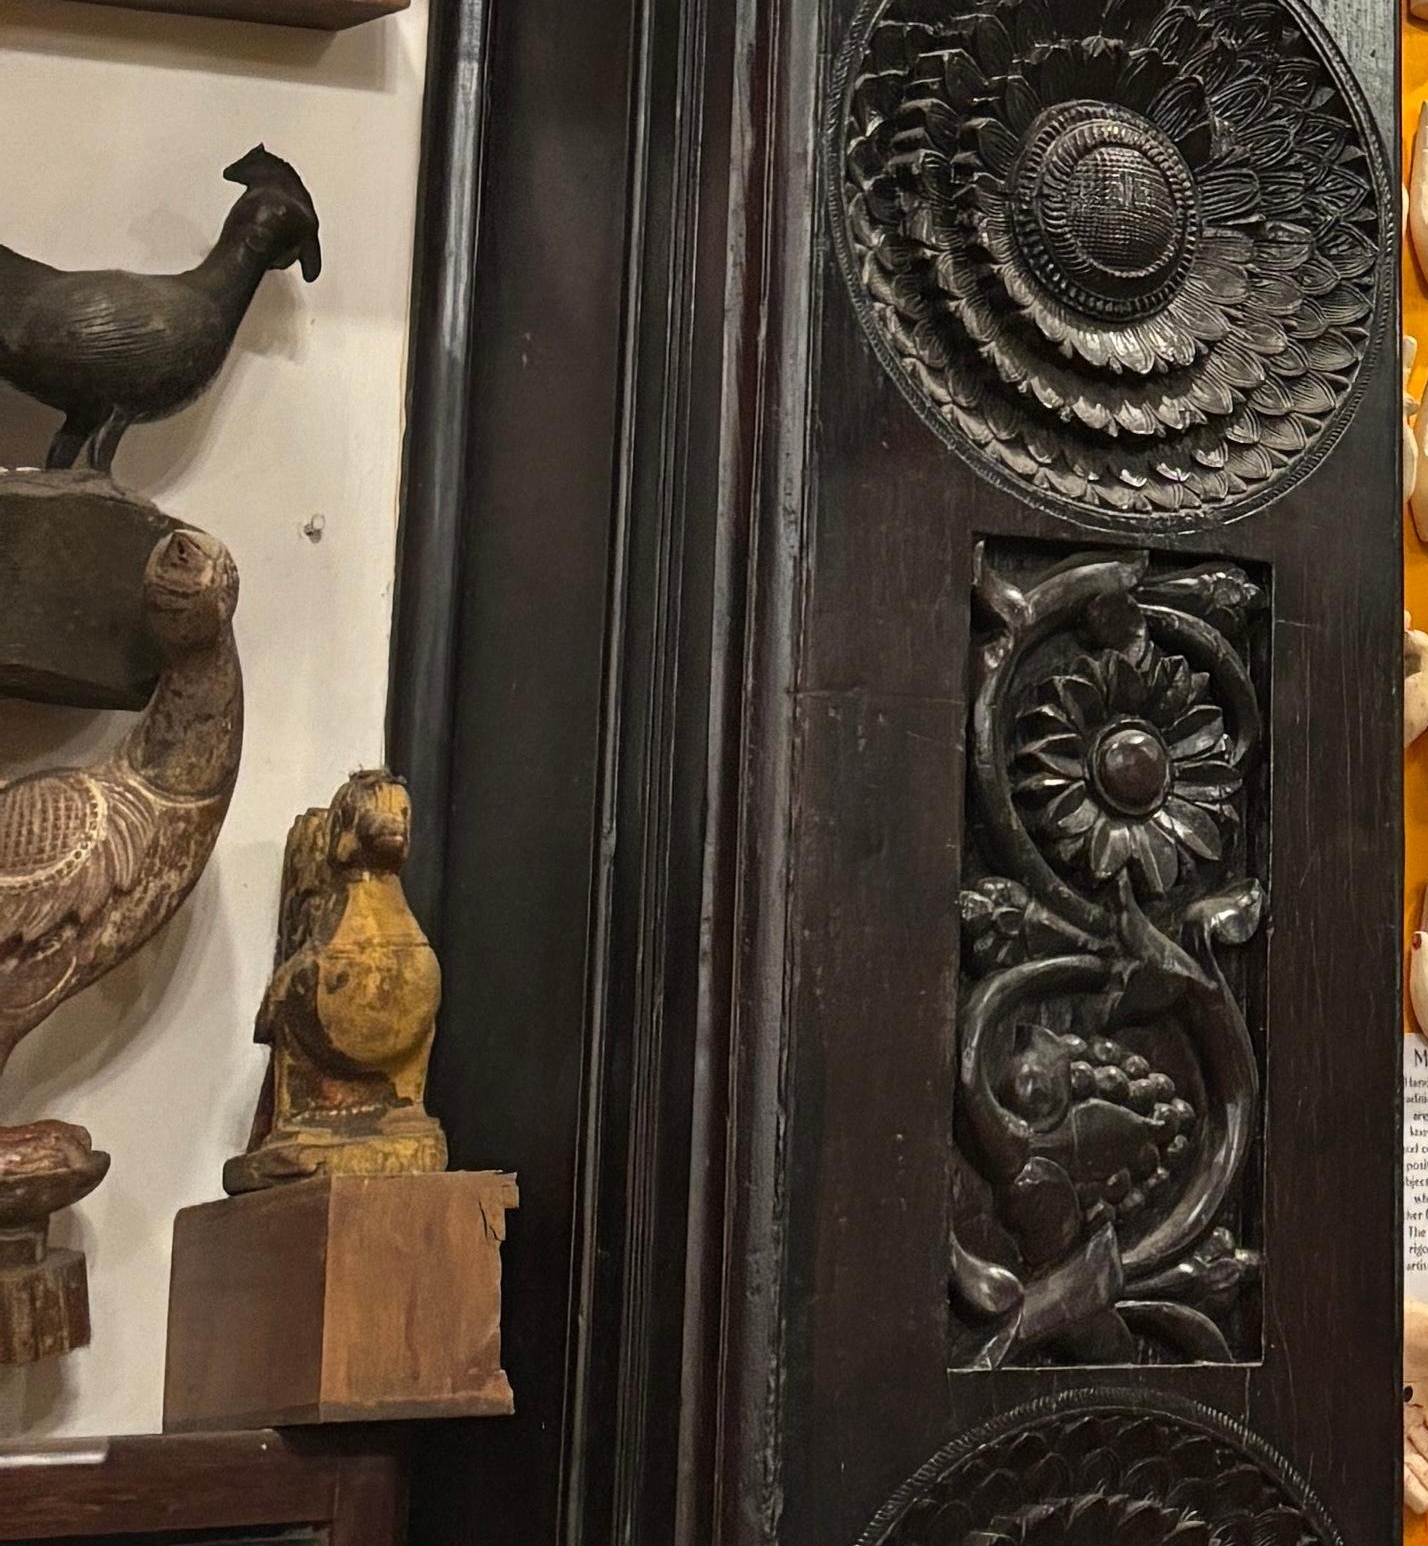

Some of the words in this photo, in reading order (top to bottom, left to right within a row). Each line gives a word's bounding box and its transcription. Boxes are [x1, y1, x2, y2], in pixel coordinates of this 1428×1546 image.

[1413, 1111, 1428, 1122] are
[1407, 1210, 1422, 1221] her
[1409, 1225, 1426, 1238] The
